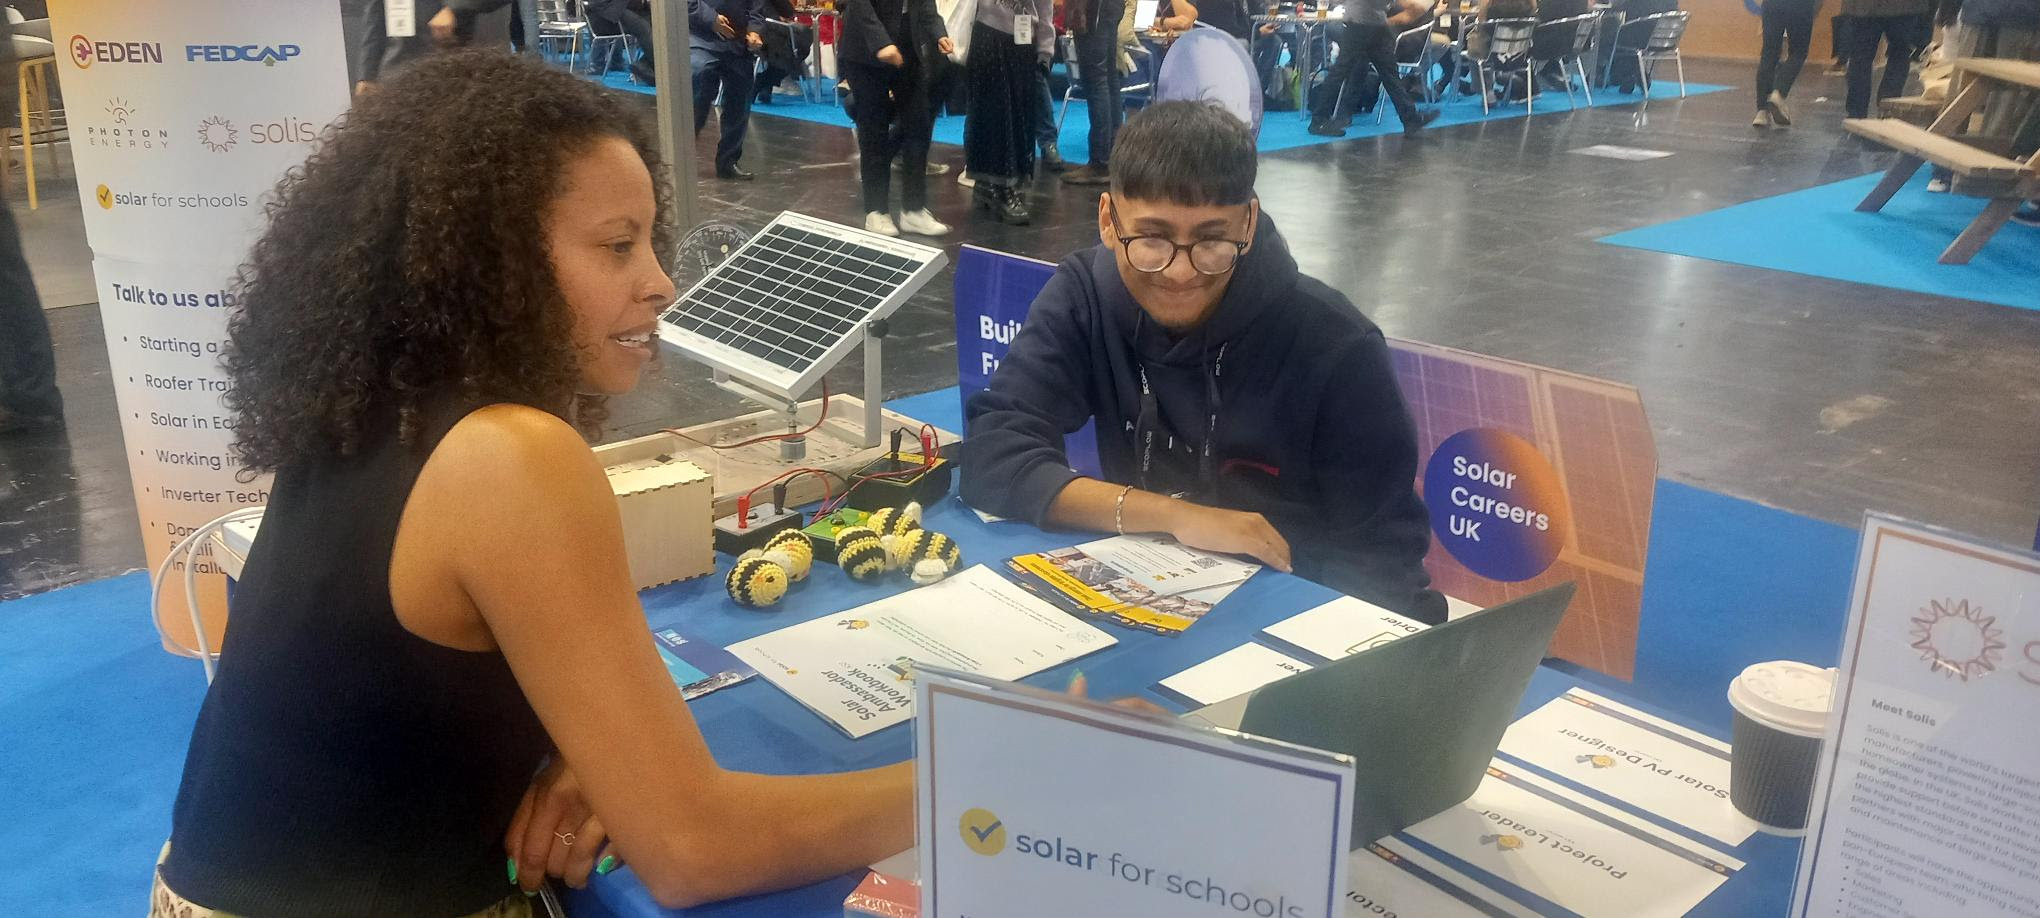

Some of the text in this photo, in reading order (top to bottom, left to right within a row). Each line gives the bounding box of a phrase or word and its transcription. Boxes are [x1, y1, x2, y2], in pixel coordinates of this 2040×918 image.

[96, 41, 163, 64] EDEN
[185, 44, 300, 63] FEDCAP
[88, 126, 168, 139] PHOTON
[250, 117, 315, 144] solis
[90, 138, 168, 149] ENERGY
[115, 191, 249, 209] solar for schools
[112, 283, 236, 307] Talk to us ab
[139, 335, 217, 358] Starting a
[145, 374, 231, 391] Roofer Trai
[151, 412, 188, 428] Solar
[192, 415, 208, 429] in
[156, 449, 221, 470] Working
[1452, 455, 1517, 490] Solar
[161, 486, 269, 503] Inverter Tech
[1450, 486, 1549, 531] Careers
[1449, 515, 1481, 541] UK
[1380, 616, 1419, 633] Drier
[1276, 662, 1301, 674] ver
[821, 670, 896, 712] Ambassador
[848, 668, 911, 707] Workbook
[841, 700, 876, 720] Solar
[1871, 697, 1936, 727] Meet Solis
[1557, 726, 1640, 767] Designer
[1641, 760, 1673, 780] PV
[1676, 771, 1730, 799] Solar
[1480, 808, 1556, 847] Leader
[1555, 837, 1629, 881] Project
[1016, 832, 1304, 918] solar for schools
